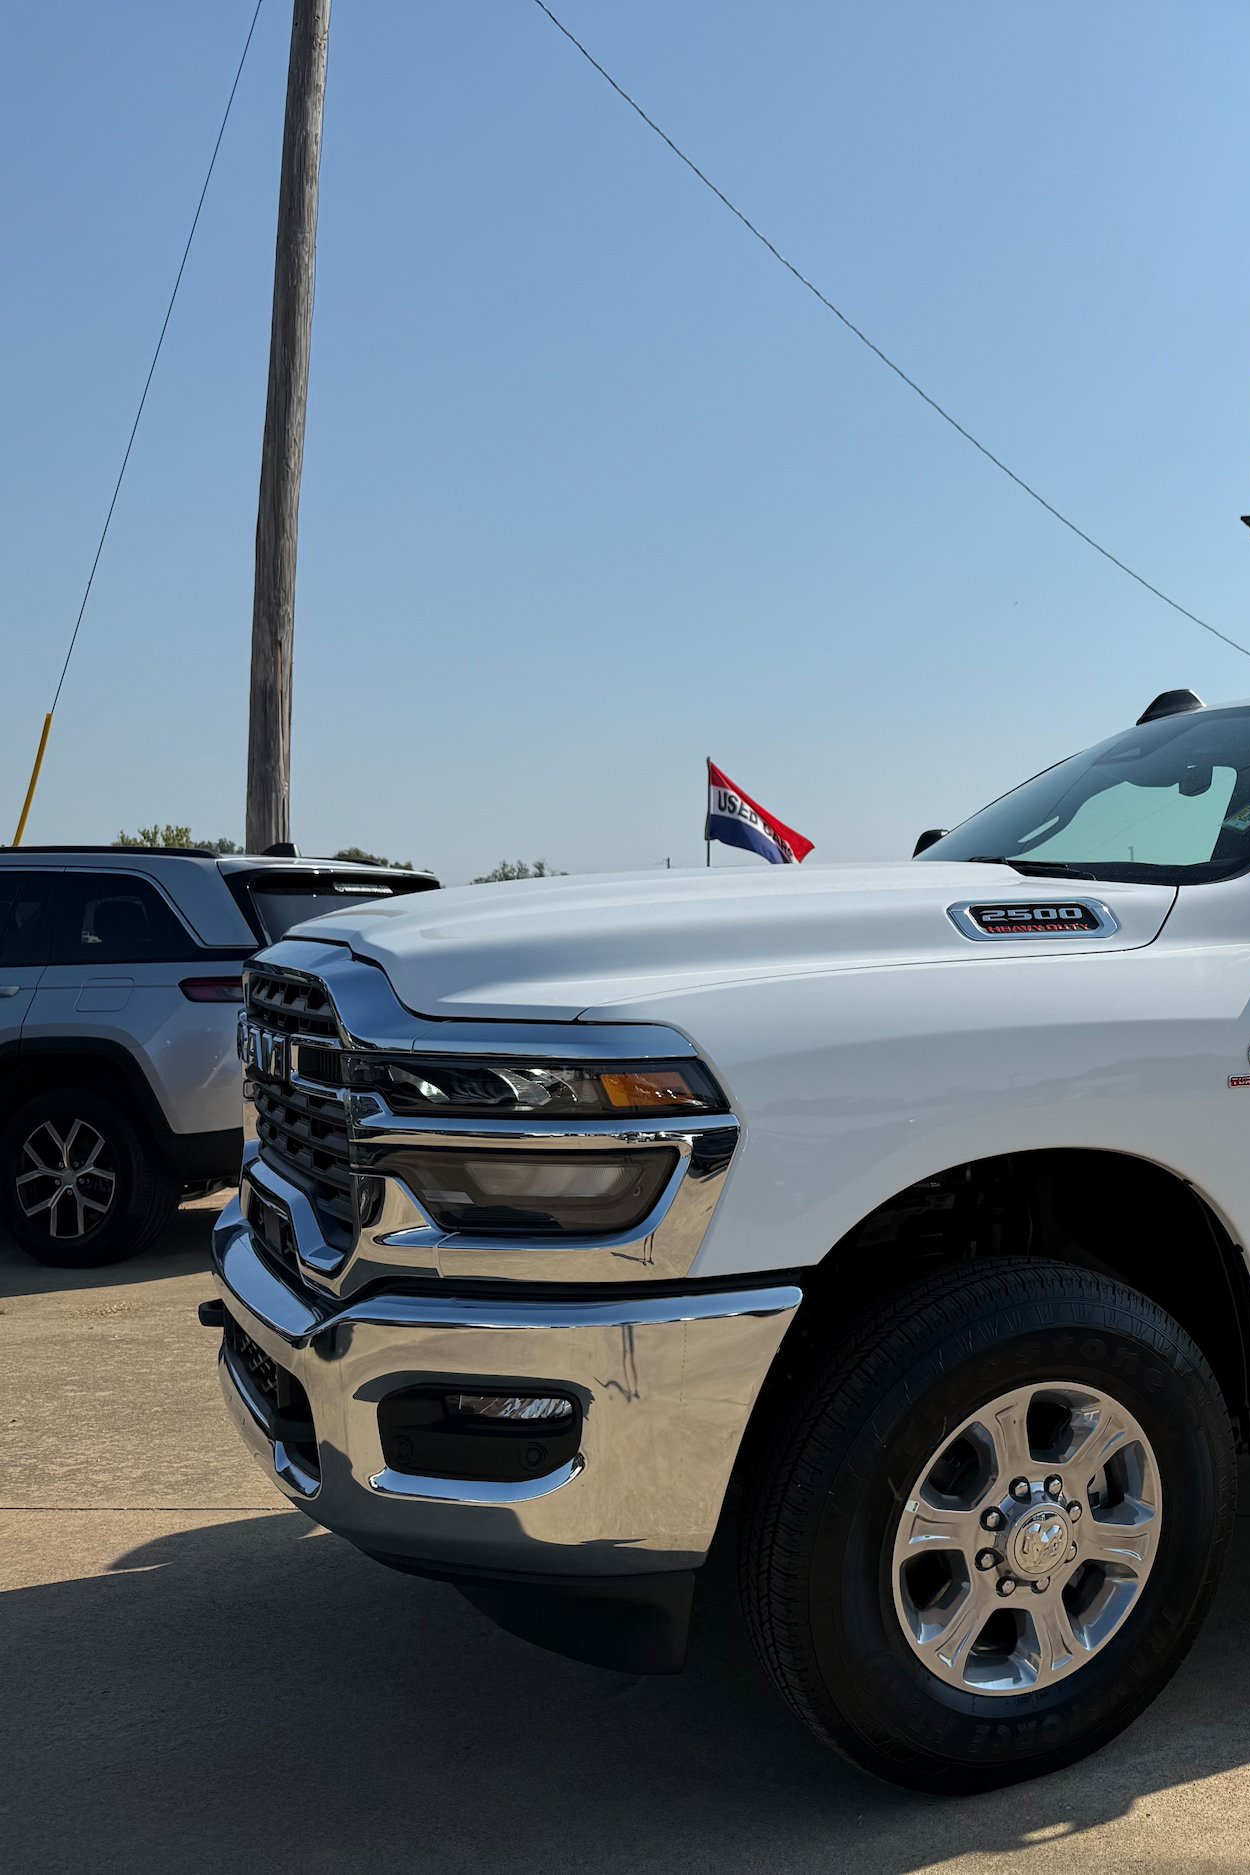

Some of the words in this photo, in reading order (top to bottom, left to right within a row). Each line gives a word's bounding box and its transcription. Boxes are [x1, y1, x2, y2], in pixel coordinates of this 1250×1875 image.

[718, 790, 758, 824] USED
[980, 907, 1083, 922] 2500
[987, 924, 1043, 933] HEAVY
[1045, 922, 1089, 932] DUTY
